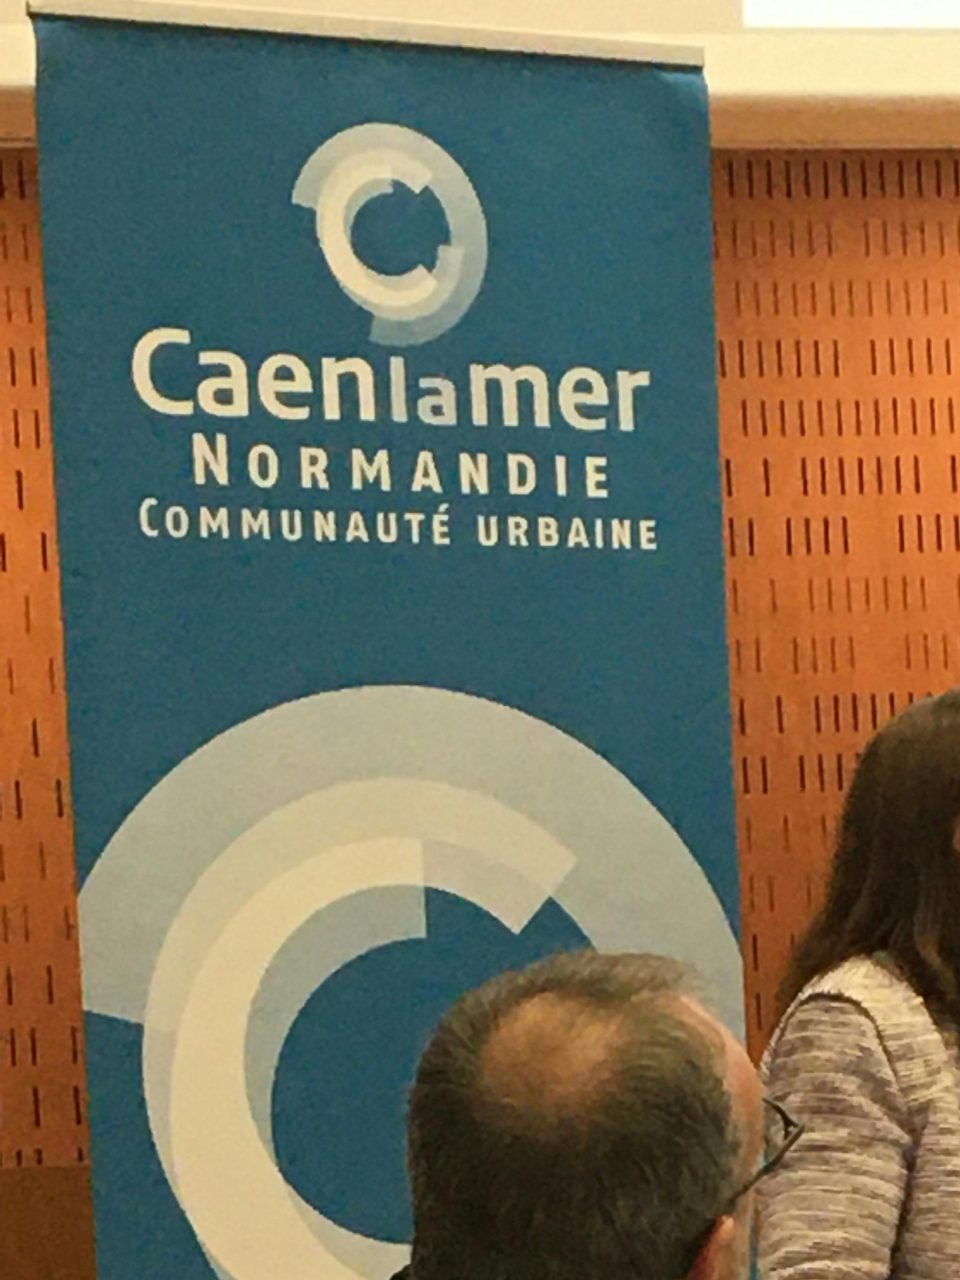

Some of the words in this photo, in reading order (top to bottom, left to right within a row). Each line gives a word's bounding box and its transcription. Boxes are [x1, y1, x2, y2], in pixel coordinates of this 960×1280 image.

[191, 432, 610, 499] NORMANDIE
[138, 497, 451, 545] COMMUNAUTÉ
[477, 514, 658, 551] URBAINE
